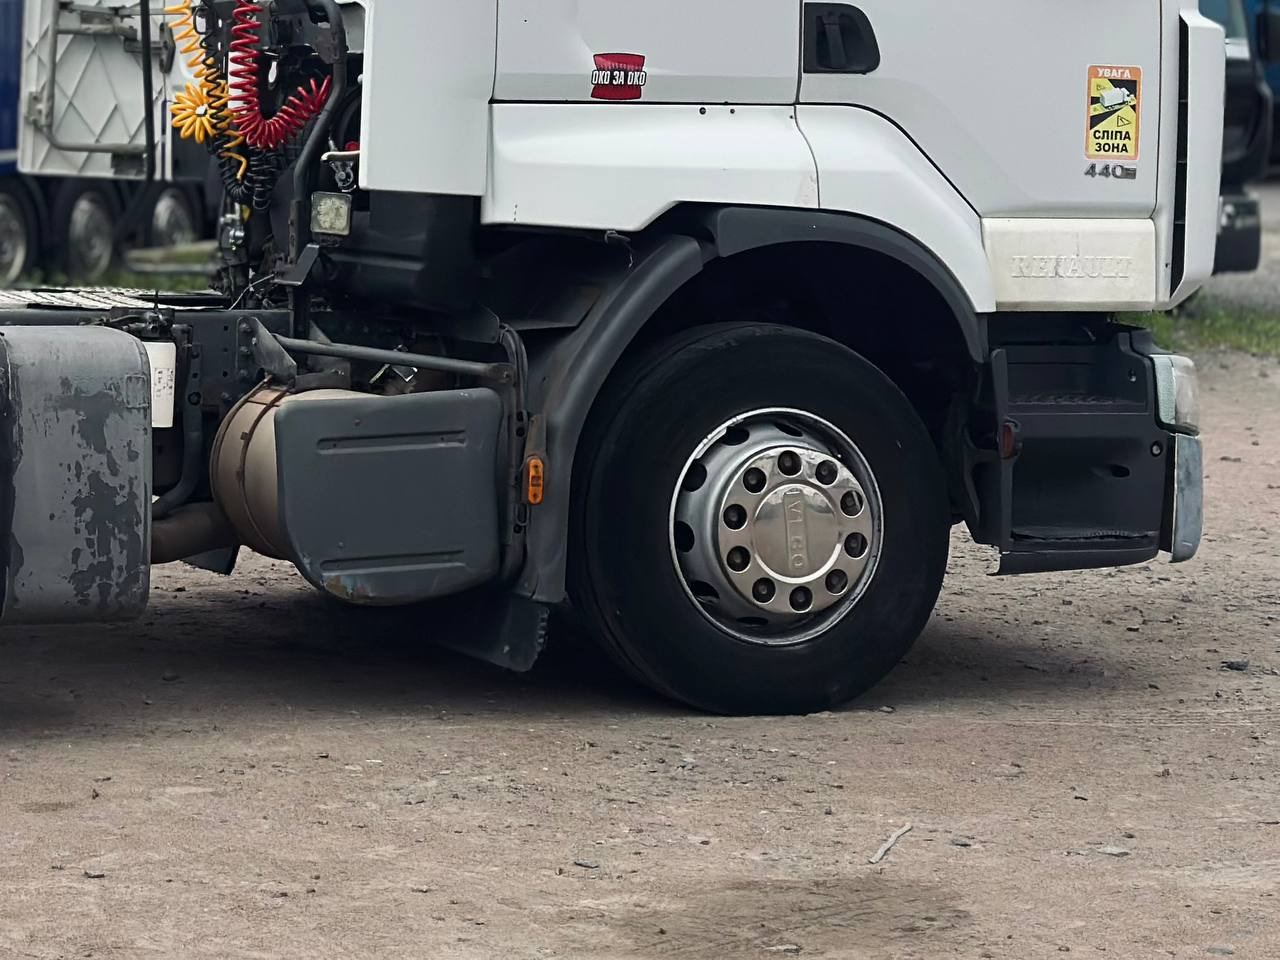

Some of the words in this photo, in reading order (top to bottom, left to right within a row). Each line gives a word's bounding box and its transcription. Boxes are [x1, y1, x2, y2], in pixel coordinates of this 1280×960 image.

[1097, 68, 1131, 79] УВАГА
[1093, 130, 1131, 141] СЛІПА
[1095, 143, 1129, 153] ЗОНА
[1011, 256, 1132, 278] RENAULT
